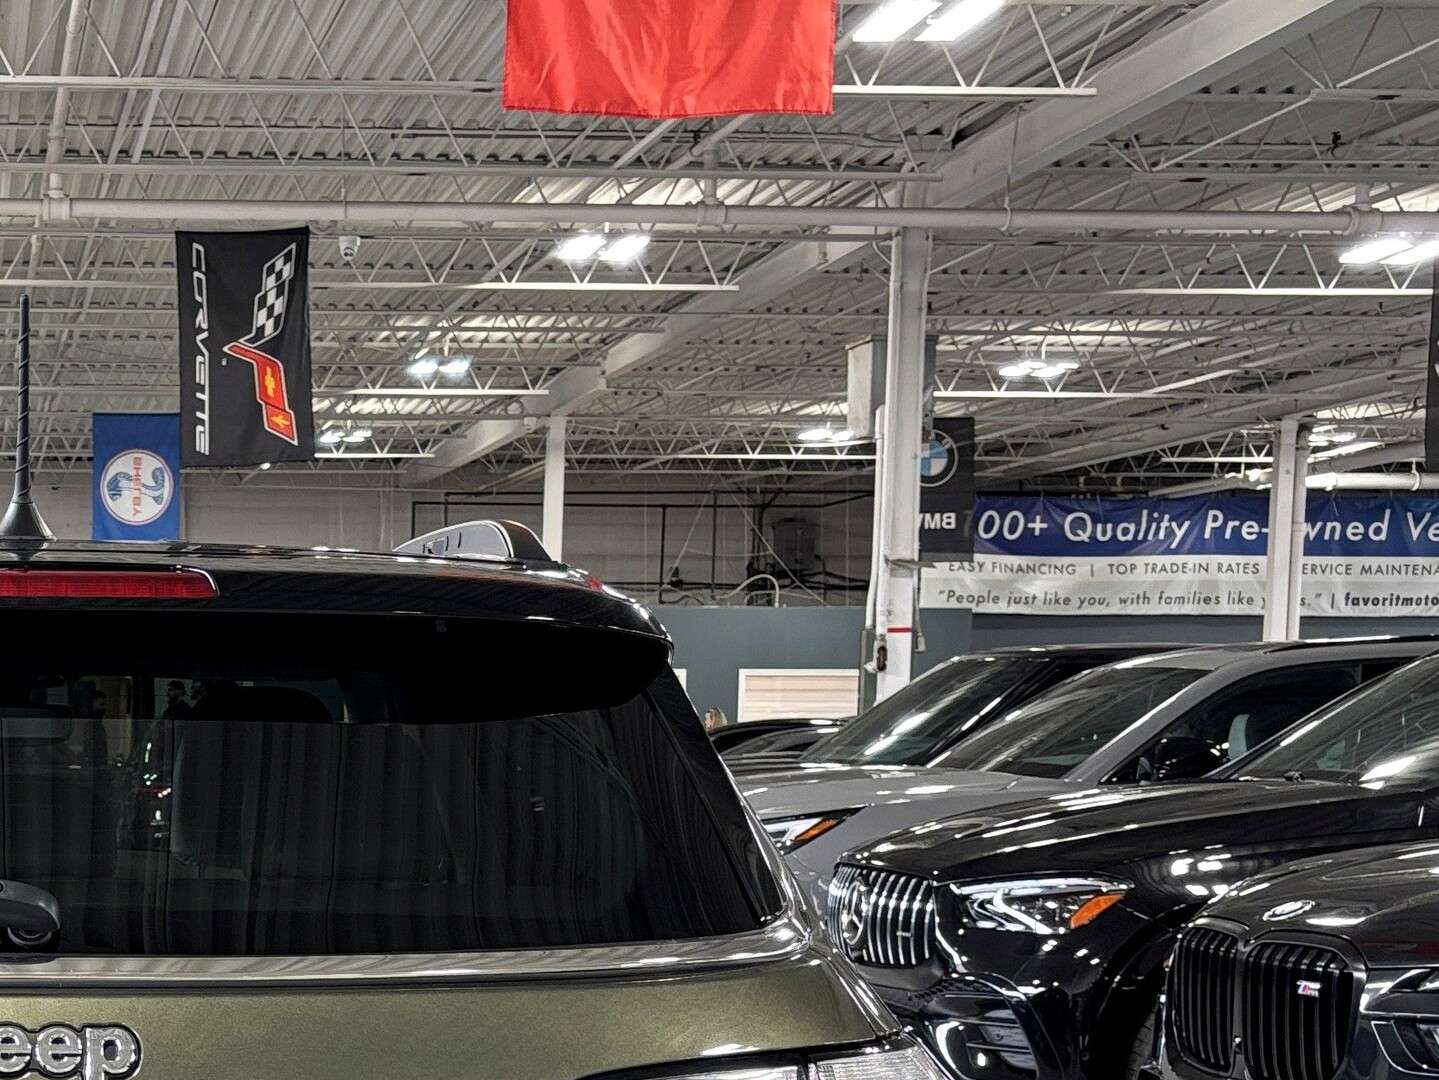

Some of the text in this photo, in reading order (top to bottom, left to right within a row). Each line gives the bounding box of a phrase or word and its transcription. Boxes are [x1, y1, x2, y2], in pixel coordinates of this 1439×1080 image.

[192, 241, 209, 456] CORVETTE
[1064, 508, 1191, 549] Quality
[1204, 508, 1391, 542] Pre-wned
[948, 561, 986, 573] EASY
[992, 562, 1077, 576] FINANCING
[1107, 562, 1137, 575] TOP
[1144, 562, 1209, 575] TRADE-IN
[1217, 562, 1260, 575] RATES
[1302, 563, 1353, 576] ERVICE
[1007, 589, 1037, 607] just
[1044, 588, 1072, 605] like
[1077, 593, 1110, 609] you,
[1119, 590, 1151, 606] with
[1158, 590, 1221, 606] families
[1227, 590, 1255, 606] like
